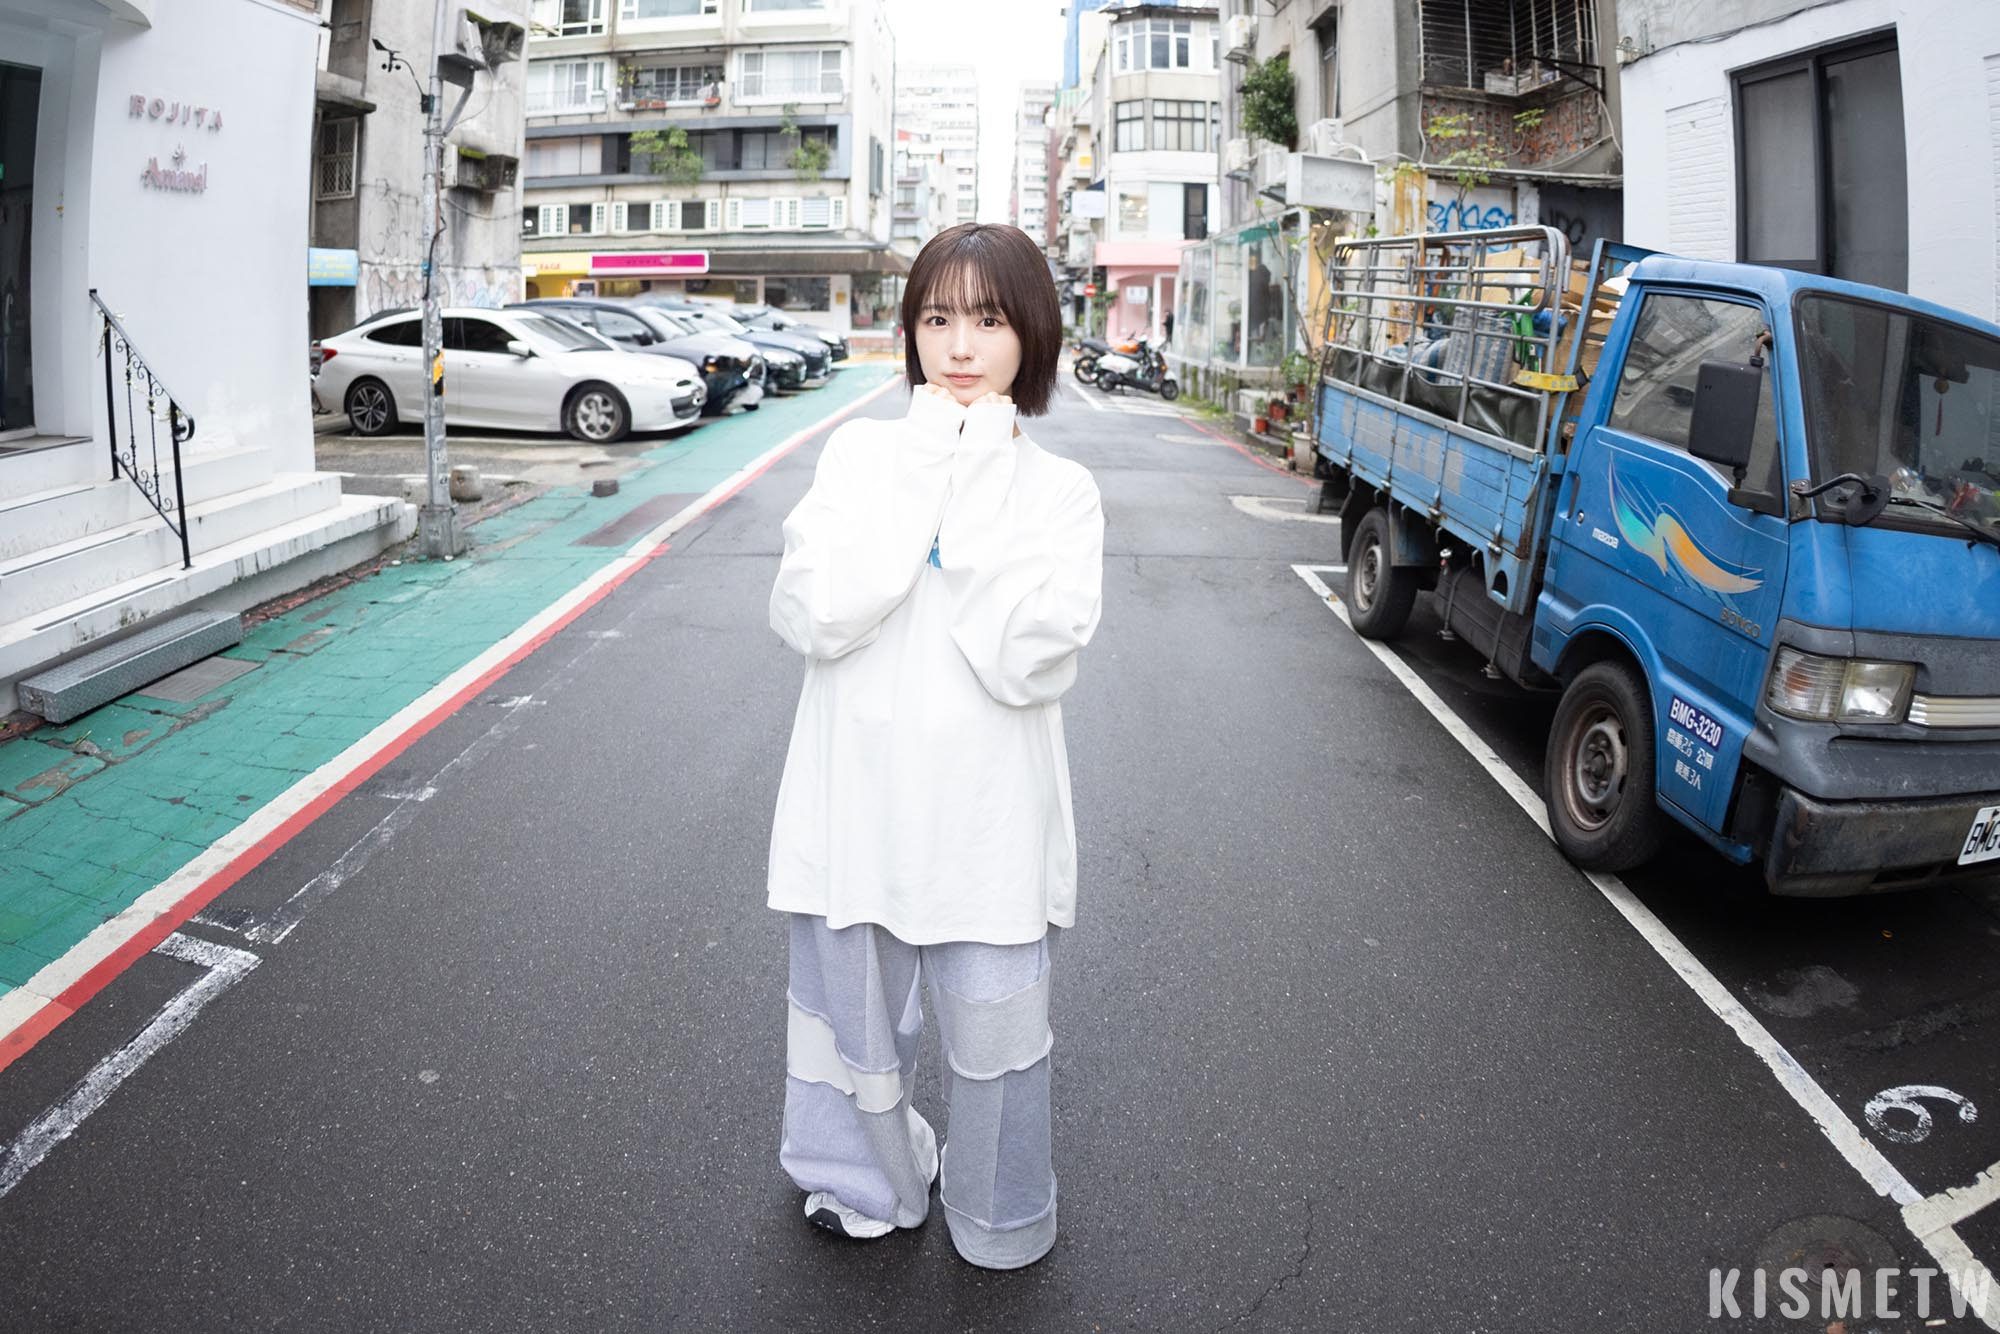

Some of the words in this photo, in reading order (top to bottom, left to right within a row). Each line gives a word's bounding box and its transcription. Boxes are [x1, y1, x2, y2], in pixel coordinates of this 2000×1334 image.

[129, 94, 223, 131] ROJITA
[1592, 527, 1619, 549] mazda
[1669, 697, 1722, 747] BMG-3230
[1964, 820, 2000, 855] BMG
